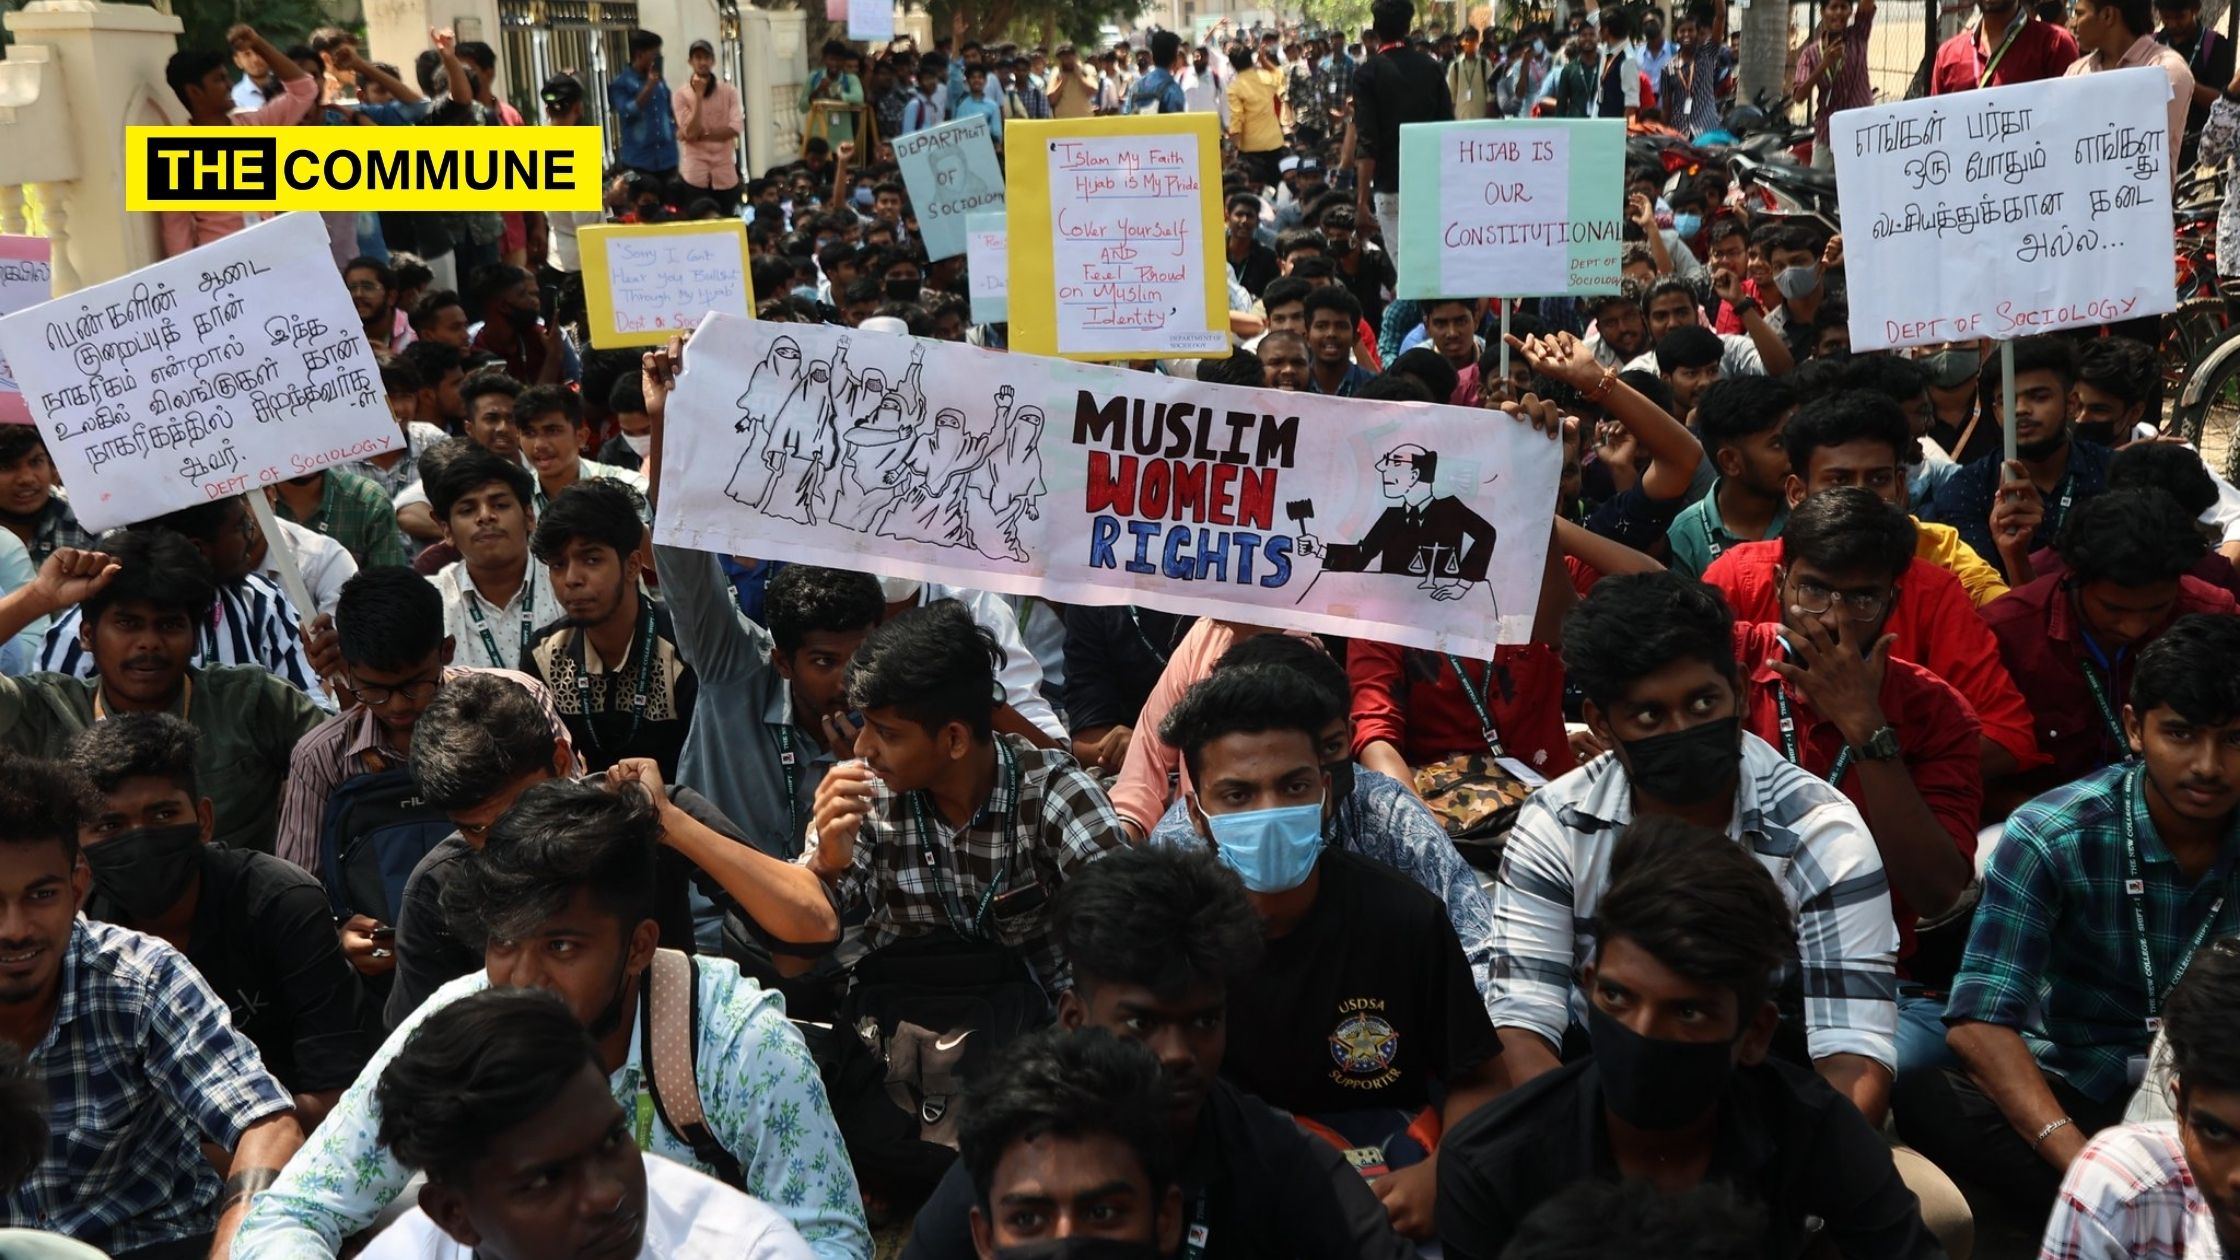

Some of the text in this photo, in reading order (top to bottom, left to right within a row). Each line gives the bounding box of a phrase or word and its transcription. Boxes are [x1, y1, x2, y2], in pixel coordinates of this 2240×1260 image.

[1855, 102, 2032, 157] எங்கள் பர்தா
[1118, 152, 1140, 175] My
[1149, 150, 1184, 164] Faith
[1459, 140, 1554, 163] HIJAB IS
[1903, 150, 1950, 190] ஒரு
[1965, 140, 2046, 184] போதும்
[1075, 176, 1115, 203] Hijab
[1144, 173, 1162, 198] My
[1165, 175, 1200, 197] Pride
[1485, 181, 1533, 206] OUR
[2089, 185, 2154, 221] தடை
[1058, 207, 1107, 238] Cover
[1444, 220, 1624, 248] CONSTITUTIONAL
[1101, 248, 1138, 264] AND
[1570, 257, 1617, 270] DEPT OF
[198, 259, 272, 301] ஆடை
[1083, 264, 1121, 281] Feel
[1059, 282, 1162, 308] on Muslim
[193, 293, 245, 344] தான்
[673, 312, 705, 330] Soci
[1886, 296, 2137, 344] DEPT OF SOCIOLOGY
[150, 334, 245, 384] என்றால்
[264, 314, 328, 348] இந்த
[55, 329, 360, 442] உலகில் விலங்குகள் தான்
[1072, 390, 1300, 468] MUSLIM
[204, 474, 249, 499] DEPT
[260, 466, 281, 482] OF
[1085, 450, 1279, 531] WOMEN
[1089, 514, 1293, 588] RIGHTS
[400, 797, 425, 808] FIL
[2125, 800, 2134, 838] COLLEGE
[2127, 839, 2136, 858] NEW
[2140, 939, 2153, 977] COLLEGE
[1338, 998, 1385, 1014] USDSA
[1328, 1067, 1402, 1090] SUPPORTER
